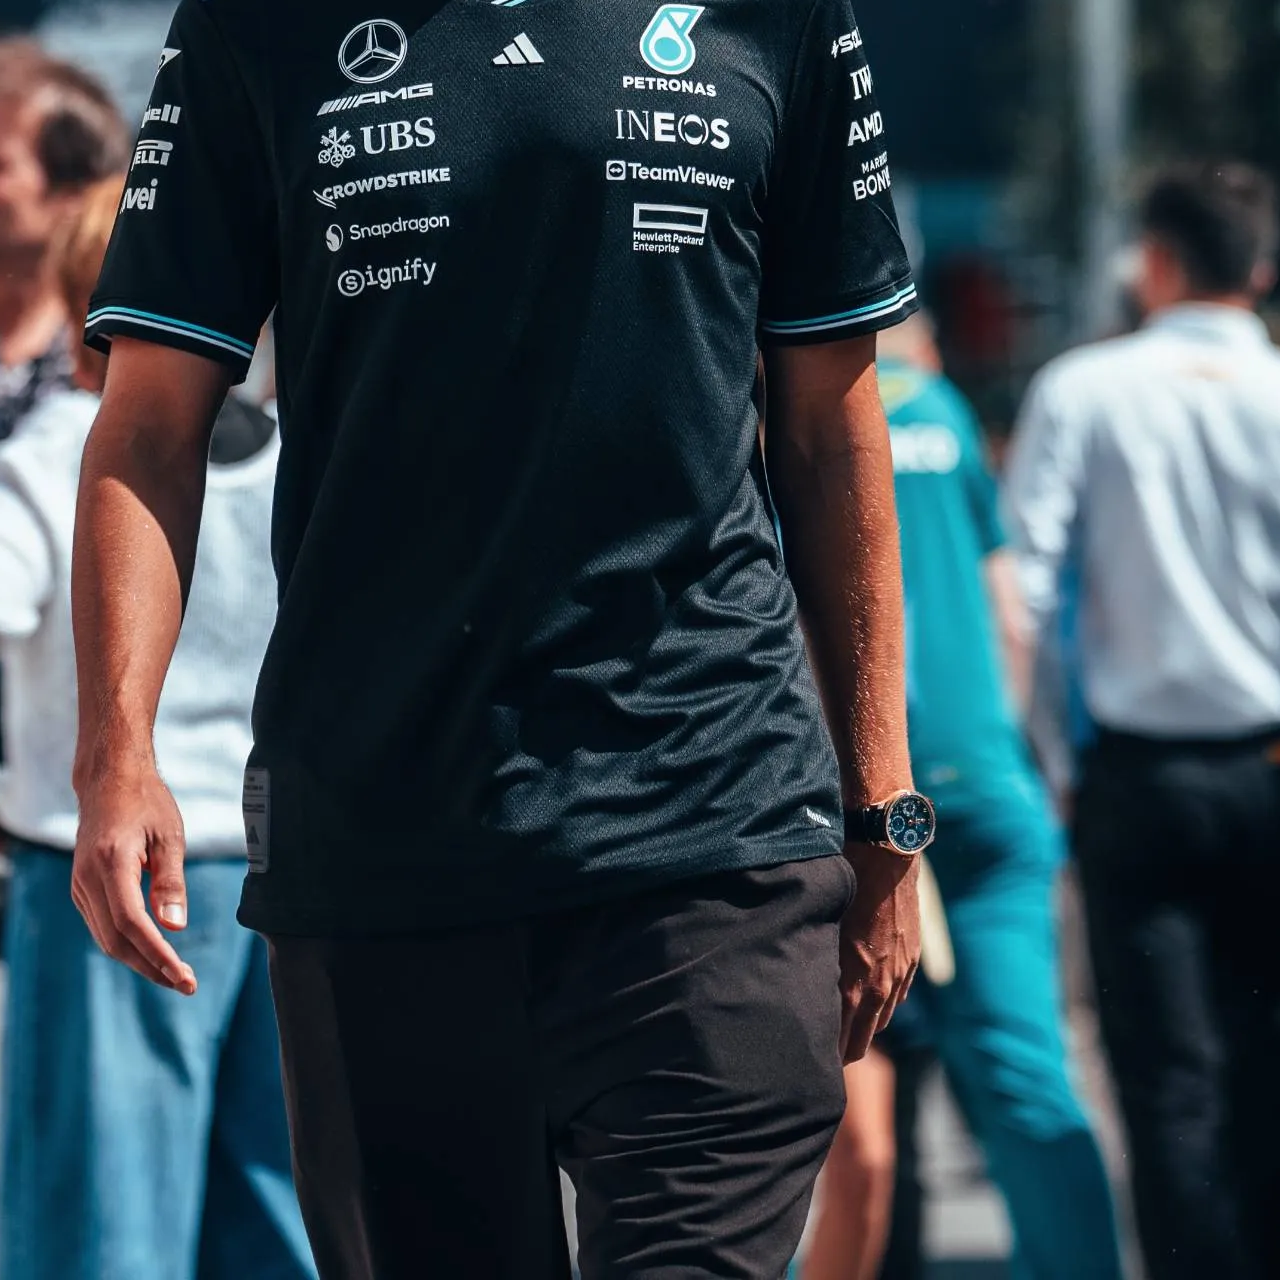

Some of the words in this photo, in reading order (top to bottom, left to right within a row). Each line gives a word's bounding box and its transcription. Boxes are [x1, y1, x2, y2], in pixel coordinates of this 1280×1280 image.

[352, 82, 434, 108] AMG
[622, 76, 717, 97] PETRONAS
[850, 64, 873, 100] IW
[360, 117, 436, 155] UBS
[614, 109, 730, 150] INEOS
[847, 110, 884, 146] AMD
[322, 167, 451, 201] CROWDSTRIKE
[627, 162, 735, 191] TeamViewer
[120, 178, 158, 214] vei
[349, 215, 450, 240] Snapdragon
[632, 231, 672, 243] Hewlett
[672, 233, 704, 246] Packard
[632, 241, 680, 254] Enterprise
